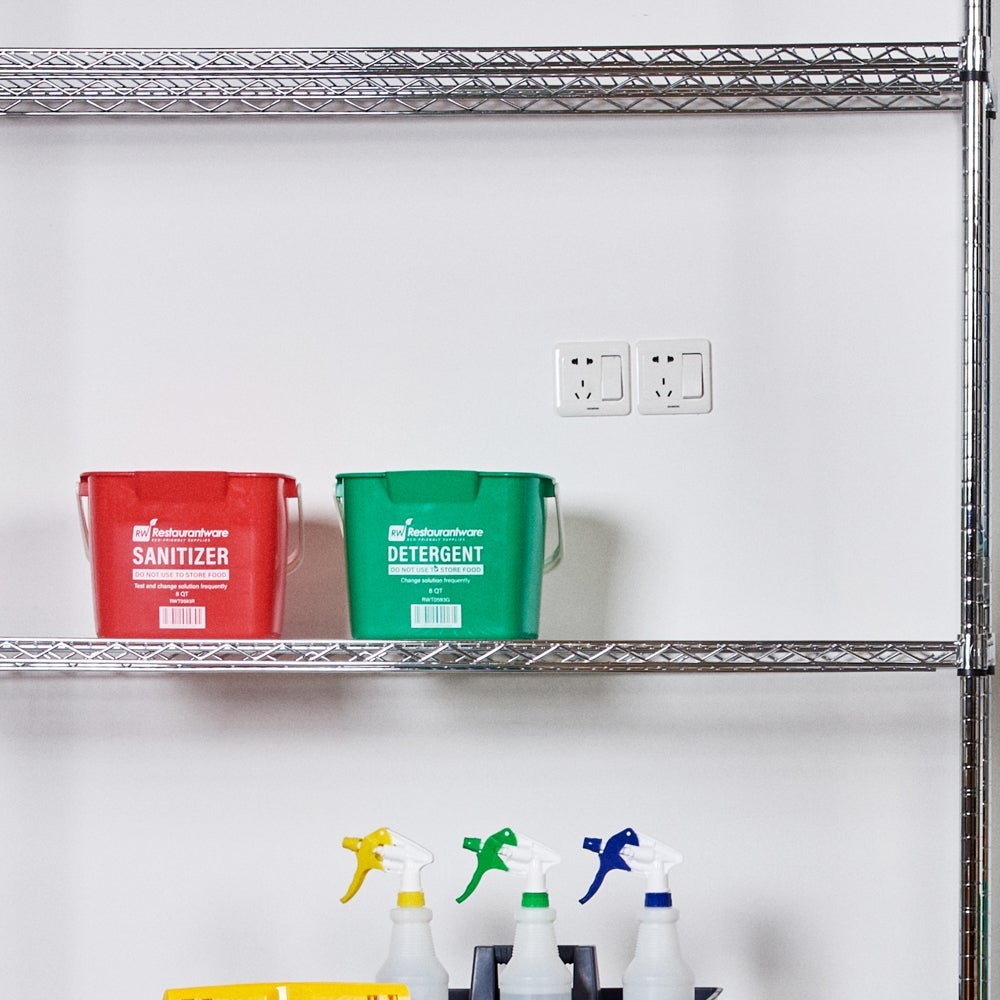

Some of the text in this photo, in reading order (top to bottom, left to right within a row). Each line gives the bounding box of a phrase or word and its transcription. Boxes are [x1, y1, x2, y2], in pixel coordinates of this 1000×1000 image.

[152, 527, 229, 538] Restaurantware
[407, 527, 484, 537] Restaurantware
[132, 546, 229, 565] SANITIZER
[388, 545, 484, 562] DETERGENT
